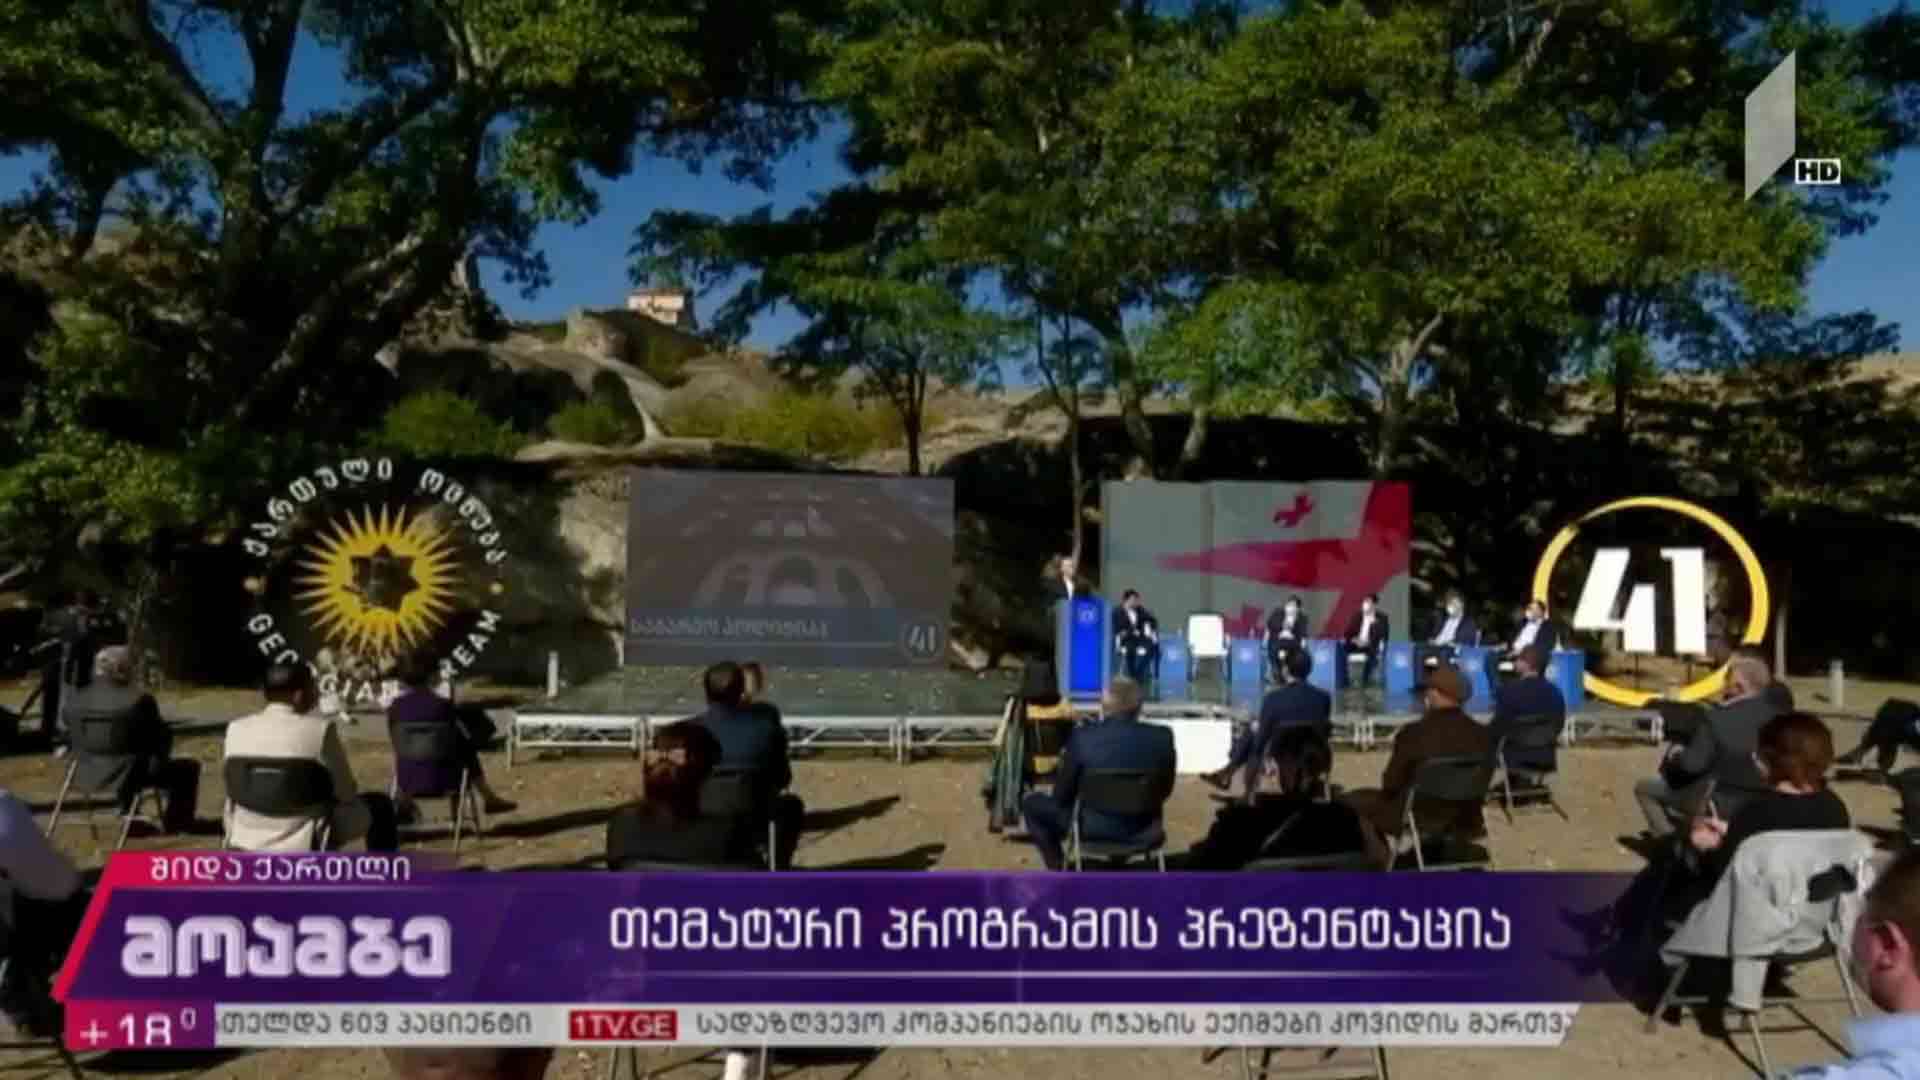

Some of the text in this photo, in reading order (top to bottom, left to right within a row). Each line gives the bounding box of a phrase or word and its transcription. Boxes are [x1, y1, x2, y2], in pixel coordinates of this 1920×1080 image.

[242, 458, 507, 563] ქართული ოცნება
[434, 609, 502, 697] REAM
[1573, 547, 1707, 655] 41
